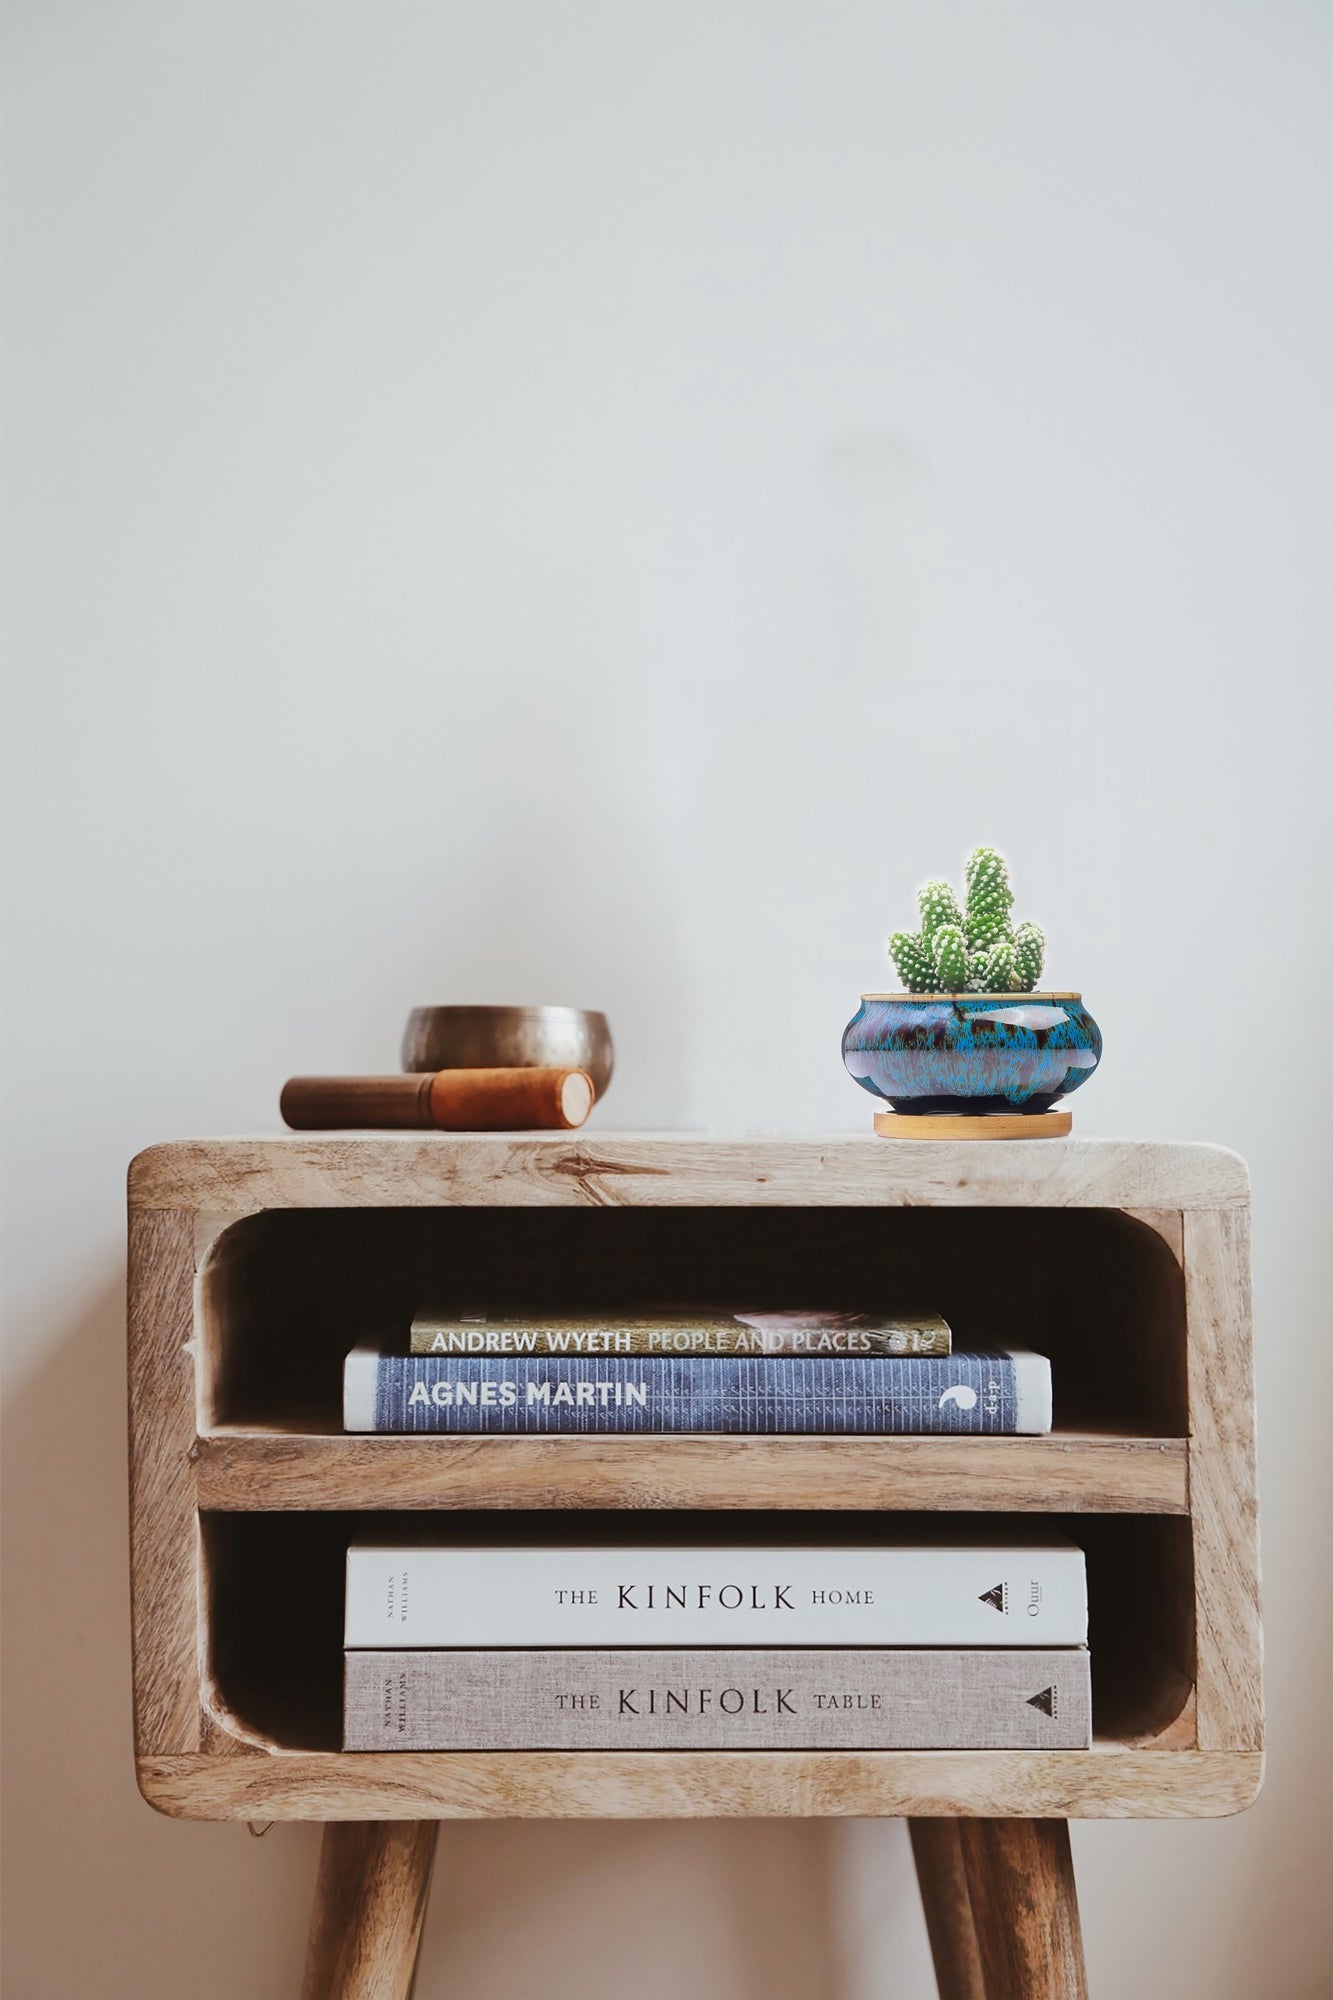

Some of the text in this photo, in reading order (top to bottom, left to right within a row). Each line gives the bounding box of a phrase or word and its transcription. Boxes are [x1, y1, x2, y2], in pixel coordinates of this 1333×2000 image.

[431, 1331, 871, 1352] ANDREW WYETH PEOPLE AND PLACES
[408, 1380, 648, 1407] AGNES MARTIN
[386, 1575, 395, 1618] NATHAN
[400, 1571, 409, 1623] WILLIAMS
[554, 1584, 875, 1610] THE KINFOLK HOME
[384, 1678, 393, 1727] NATHAN
[397, 1672, 406, 1733] WILLIAMS
[554, 1688, 882, 1715] THE KINFOLK TABLE
